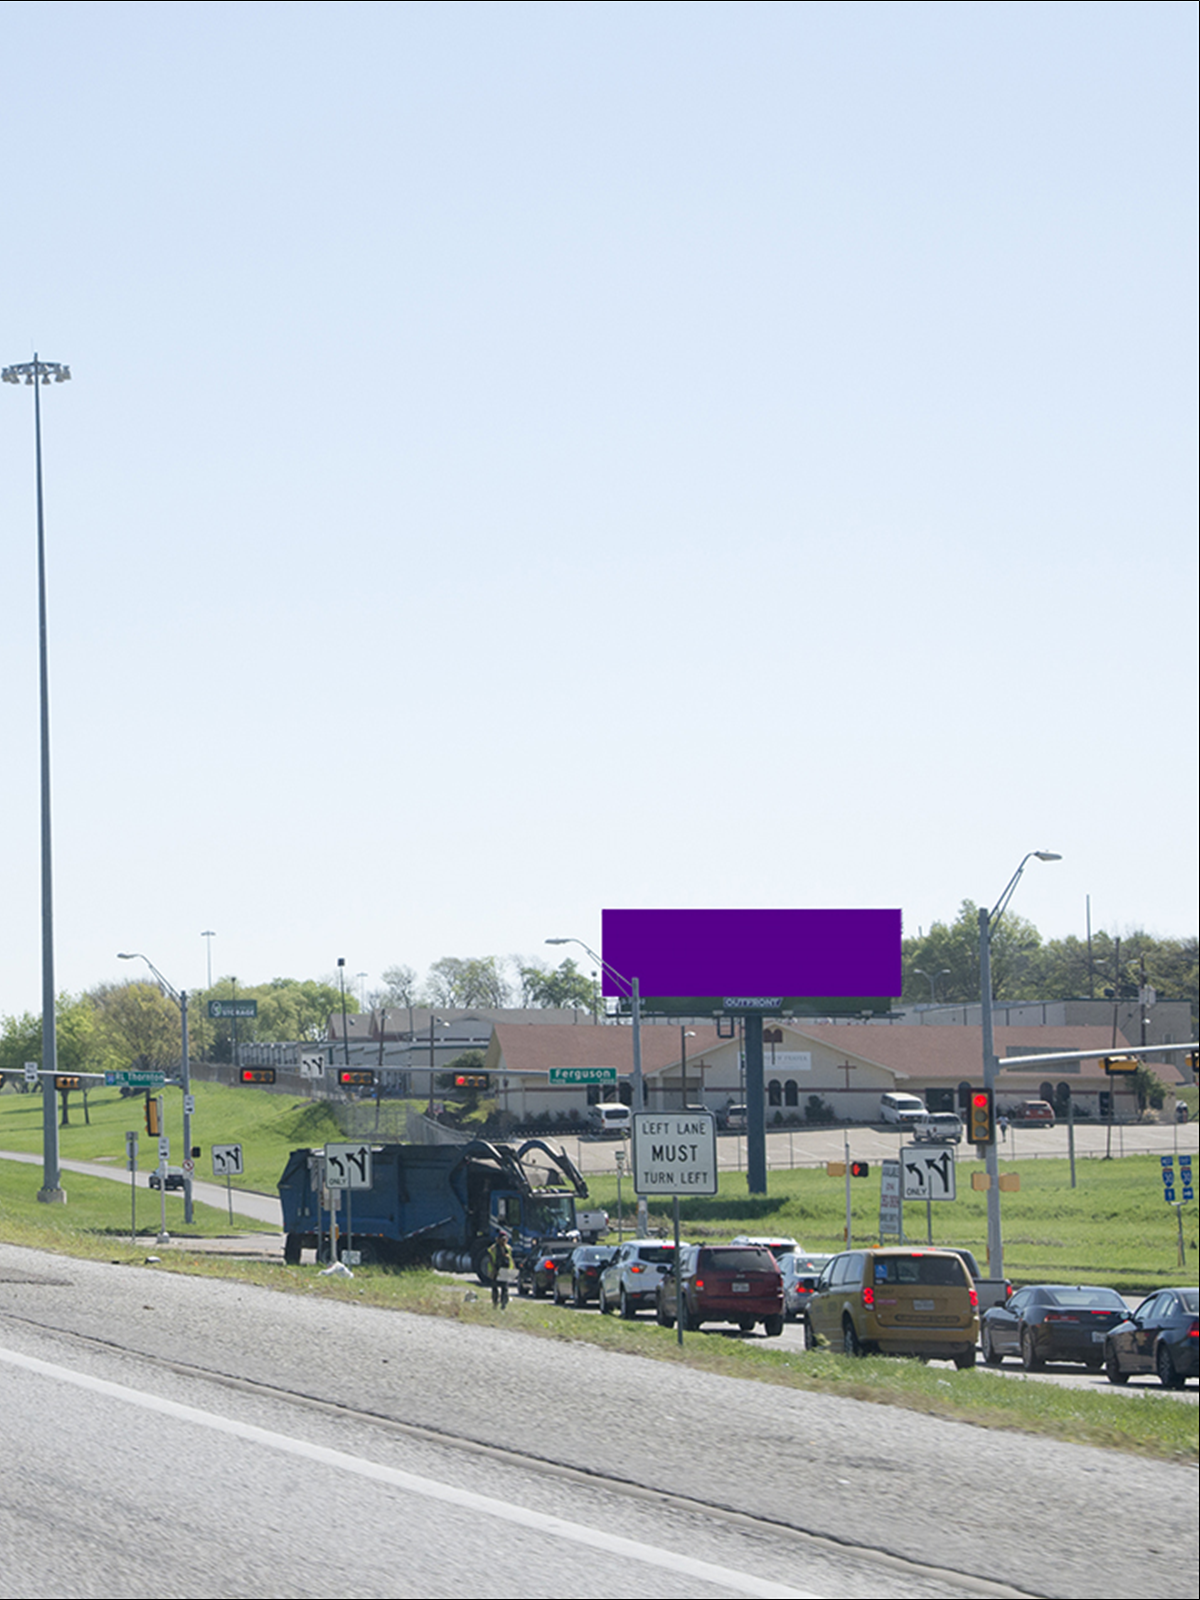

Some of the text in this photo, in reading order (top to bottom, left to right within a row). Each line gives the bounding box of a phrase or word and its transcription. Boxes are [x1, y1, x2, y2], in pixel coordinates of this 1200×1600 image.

[725, 998, 781, 1007] OUTFRONT
[128, 1072, 164, 1081] Thornton
[555, 1069, 611, 1080] Ferguson
[642, 1122, 706, 1135] LEFT LANE
[651, 1145, 698, 1162] MUST
[329, 1178, 347, 1186] ONLY
[644, 1171, 708, 1185] TURN LEFT
[906, 1187, 927, 1196] ONLY
